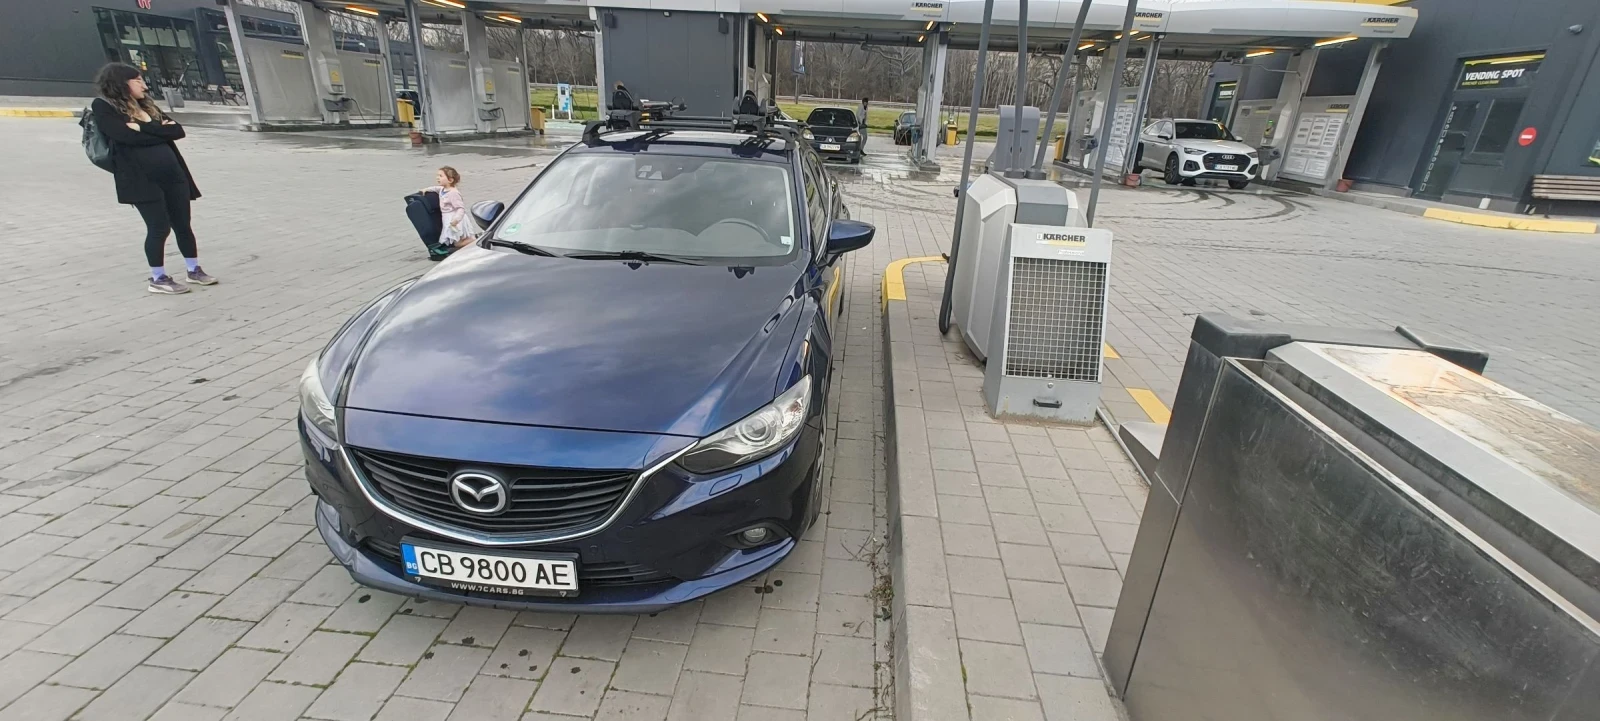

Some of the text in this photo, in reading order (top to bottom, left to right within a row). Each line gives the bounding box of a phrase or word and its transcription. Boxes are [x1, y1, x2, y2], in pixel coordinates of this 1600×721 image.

[1465, 68, 1525, 80] VENDING SPOT
[406, 562, 418, 570] BG
[421, 551, 571, 586] CB 9800 AE
